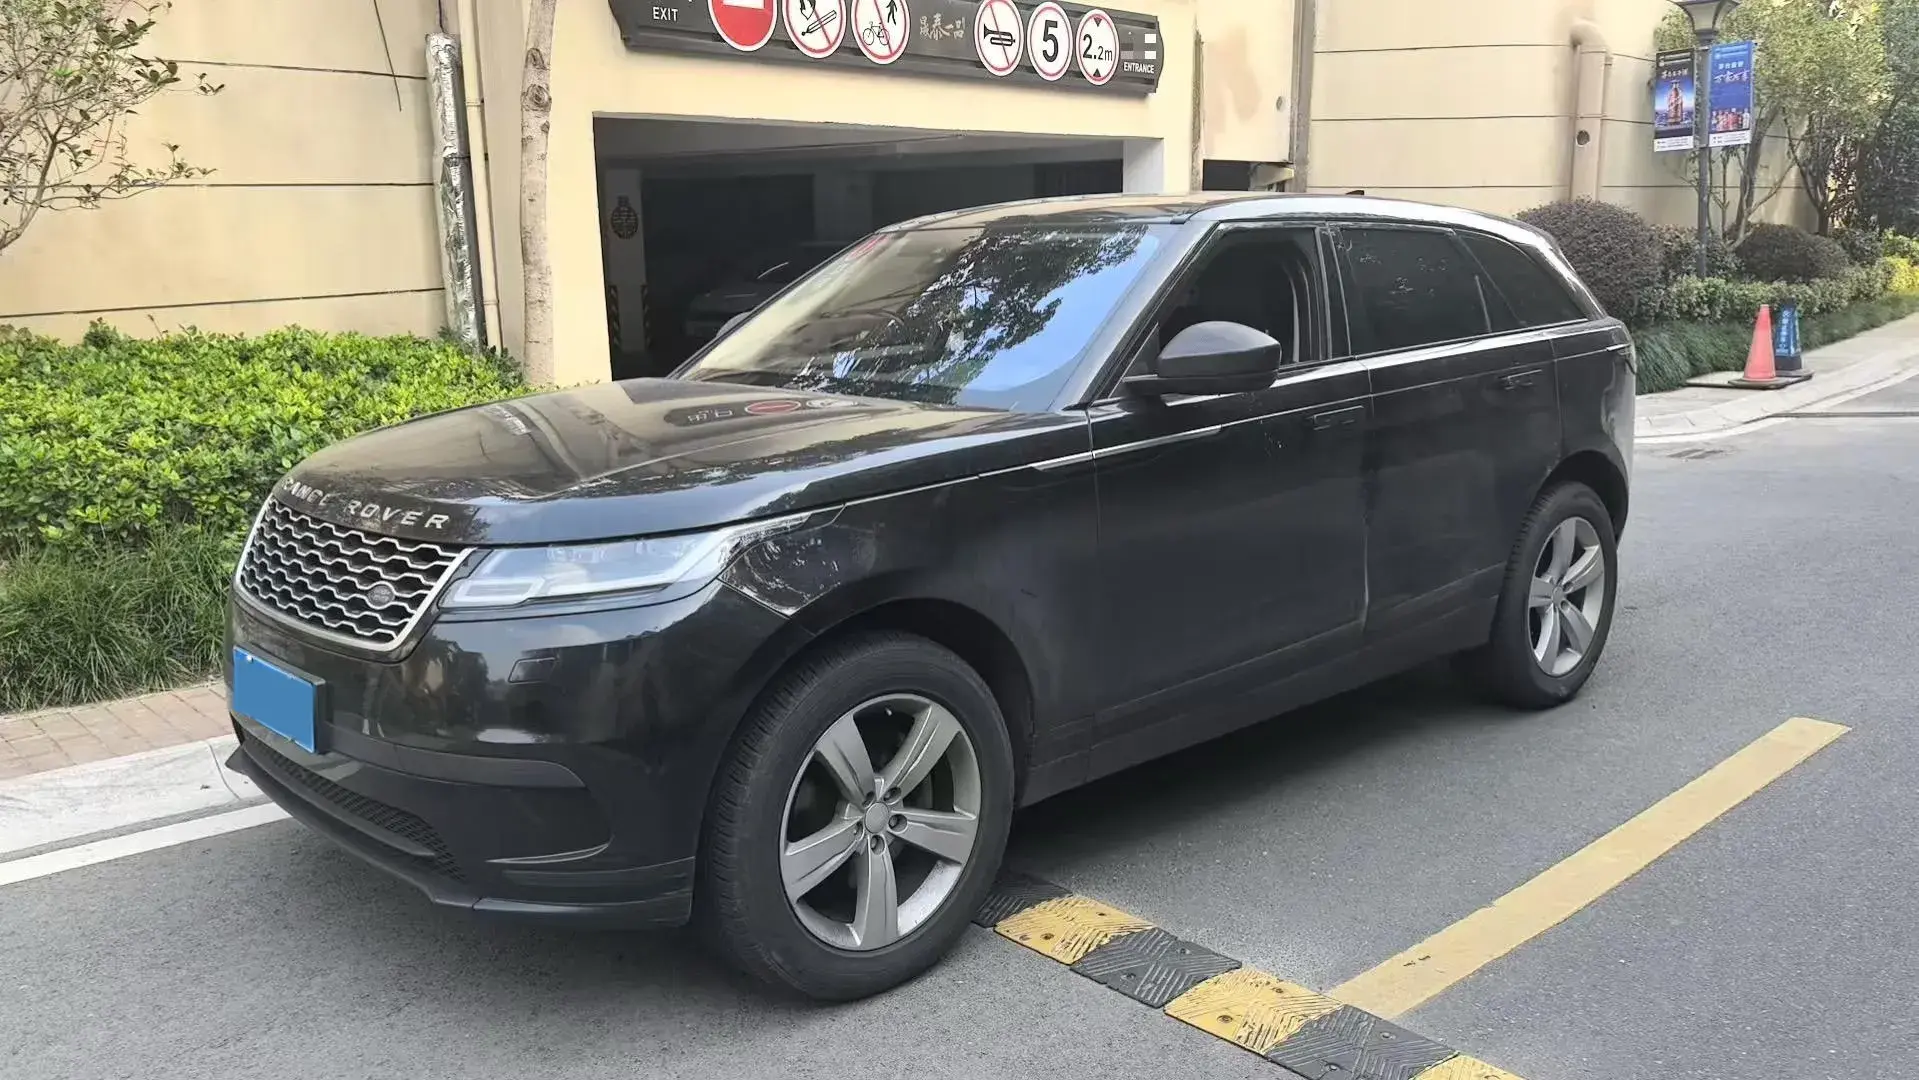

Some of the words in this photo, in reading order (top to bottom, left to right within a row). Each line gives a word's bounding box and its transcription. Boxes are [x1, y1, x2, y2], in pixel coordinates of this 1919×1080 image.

[652, 6, 678, 21] EXIT
[1042, 19, 1059, 62] 5
[1082, 33, 1113, 61] 2.2m
[1123, 61, 1155, 74] ENTRANCE
[346, 499, 450, 529] ROVER
